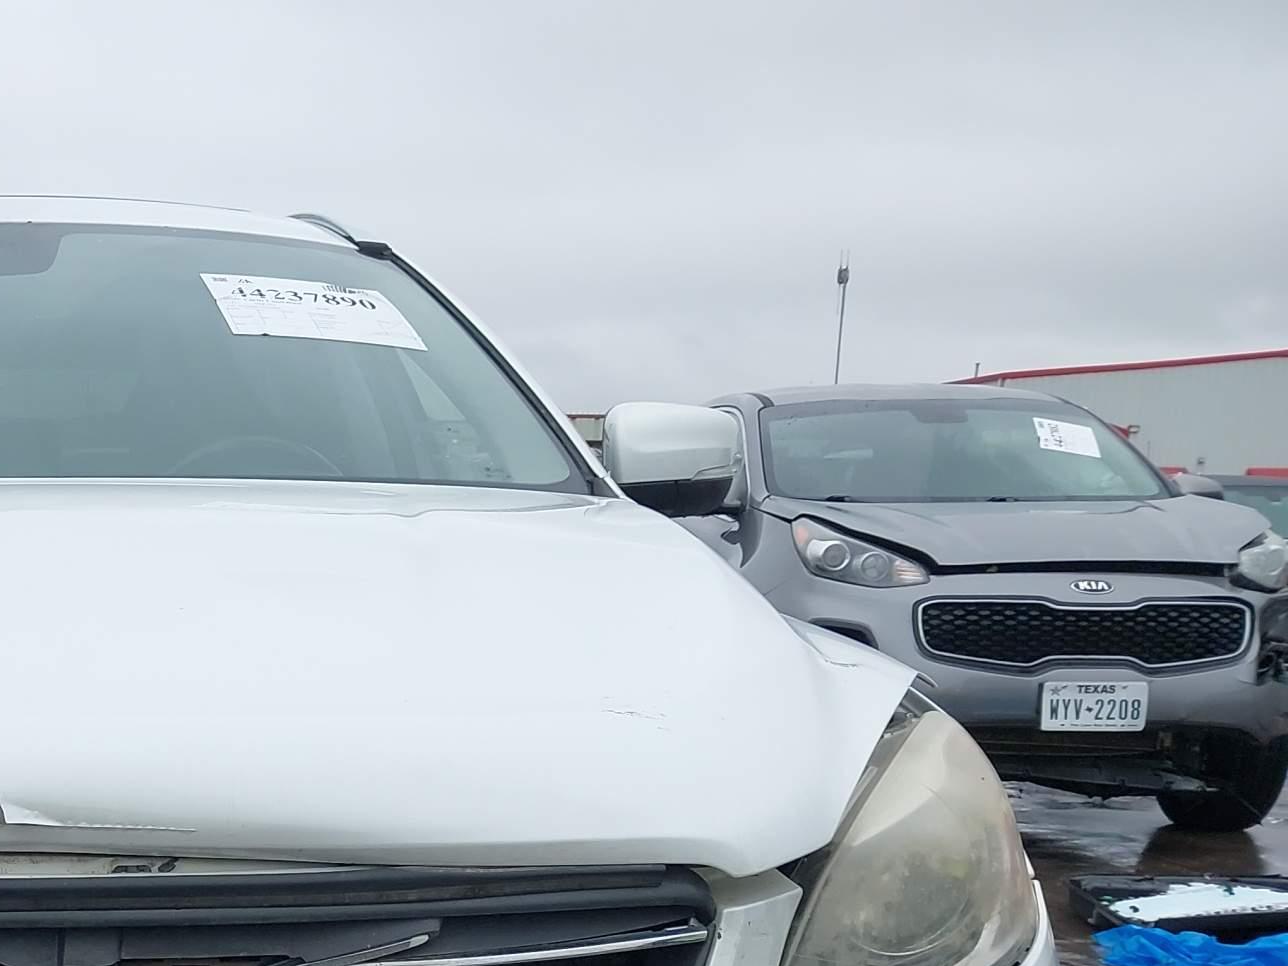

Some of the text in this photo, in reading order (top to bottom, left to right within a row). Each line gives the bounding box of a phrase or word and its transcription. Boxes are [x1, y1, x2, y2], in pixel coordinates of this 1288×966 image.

[231, 286, 377, 310] 44237890
[1078, 581, 1110, 590] KIA
[1076, 684, 1117, 695] TEXAS
